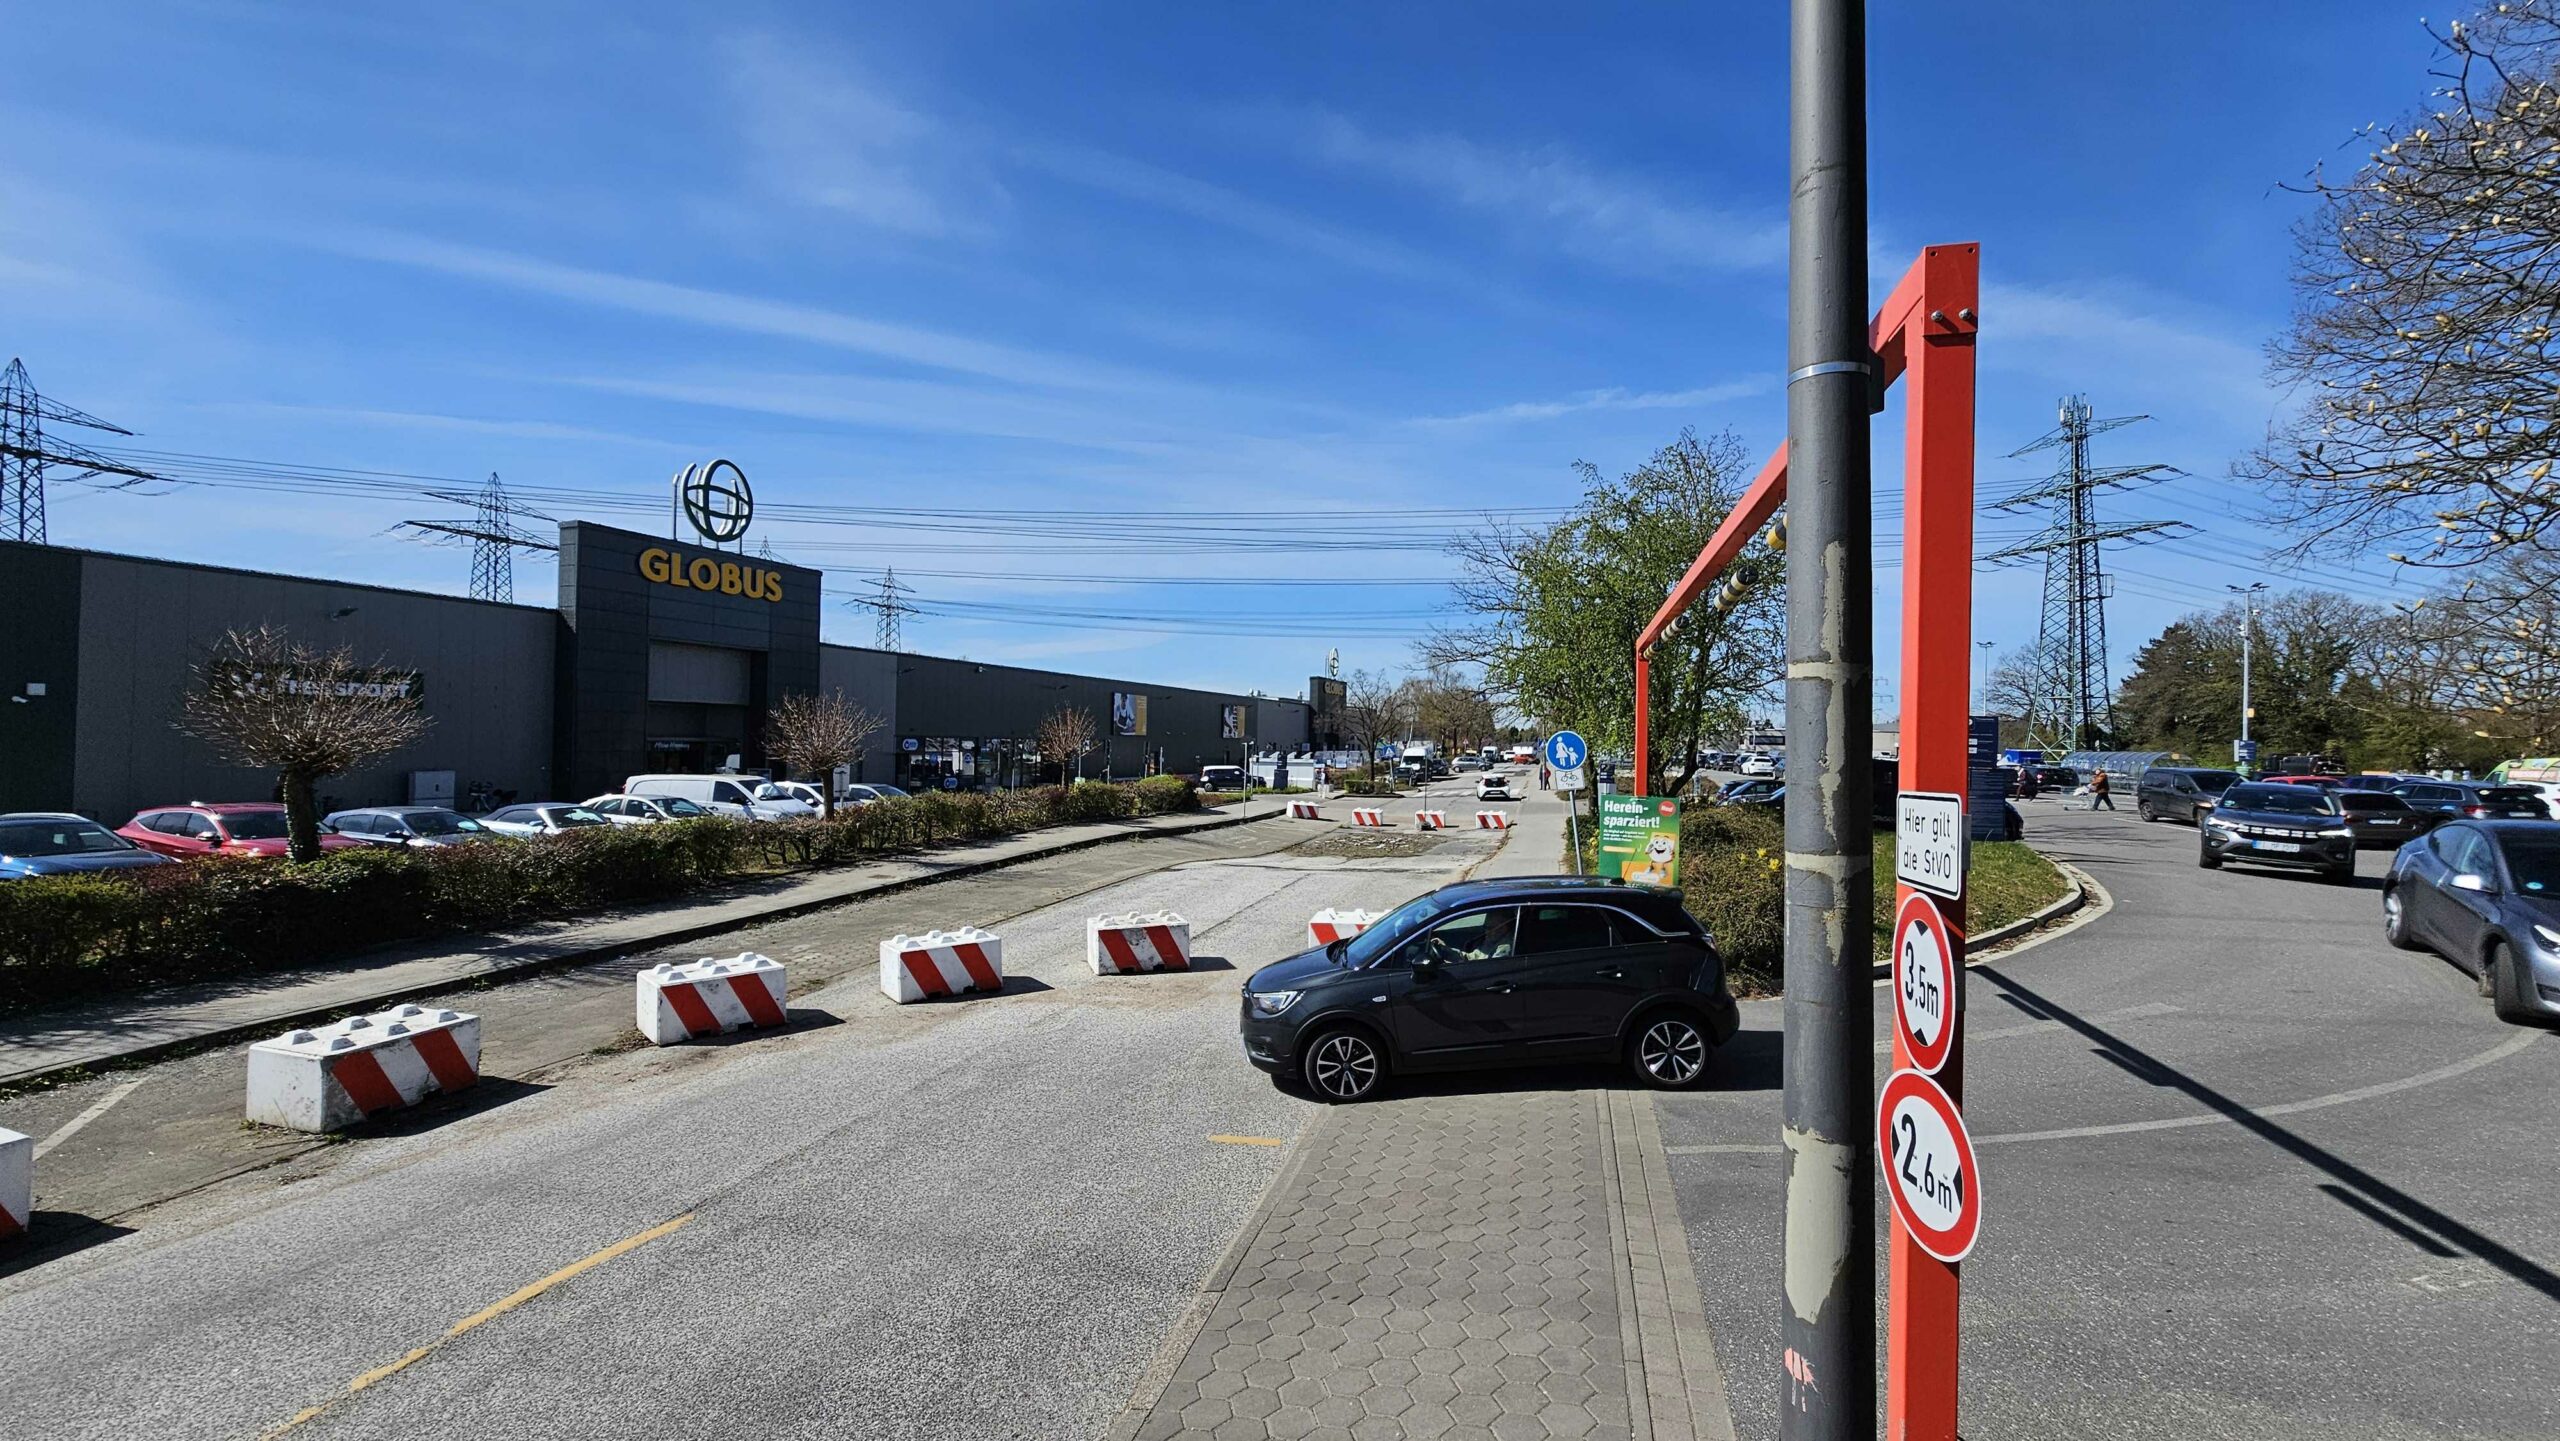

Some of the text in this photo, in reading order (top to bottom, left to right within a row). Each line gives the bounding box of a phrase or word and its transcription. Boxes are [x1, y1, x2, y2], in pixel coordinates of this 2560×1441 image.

[639, 548, 783, 602] GLOBUS
[1603, 816, 1660, 828] sparziert!
[1604, 800, 1649, 814] Herein-
[1904, 807, 1951, 843] Hier gilt
[1903, 845, 1951, 879] die StVO
